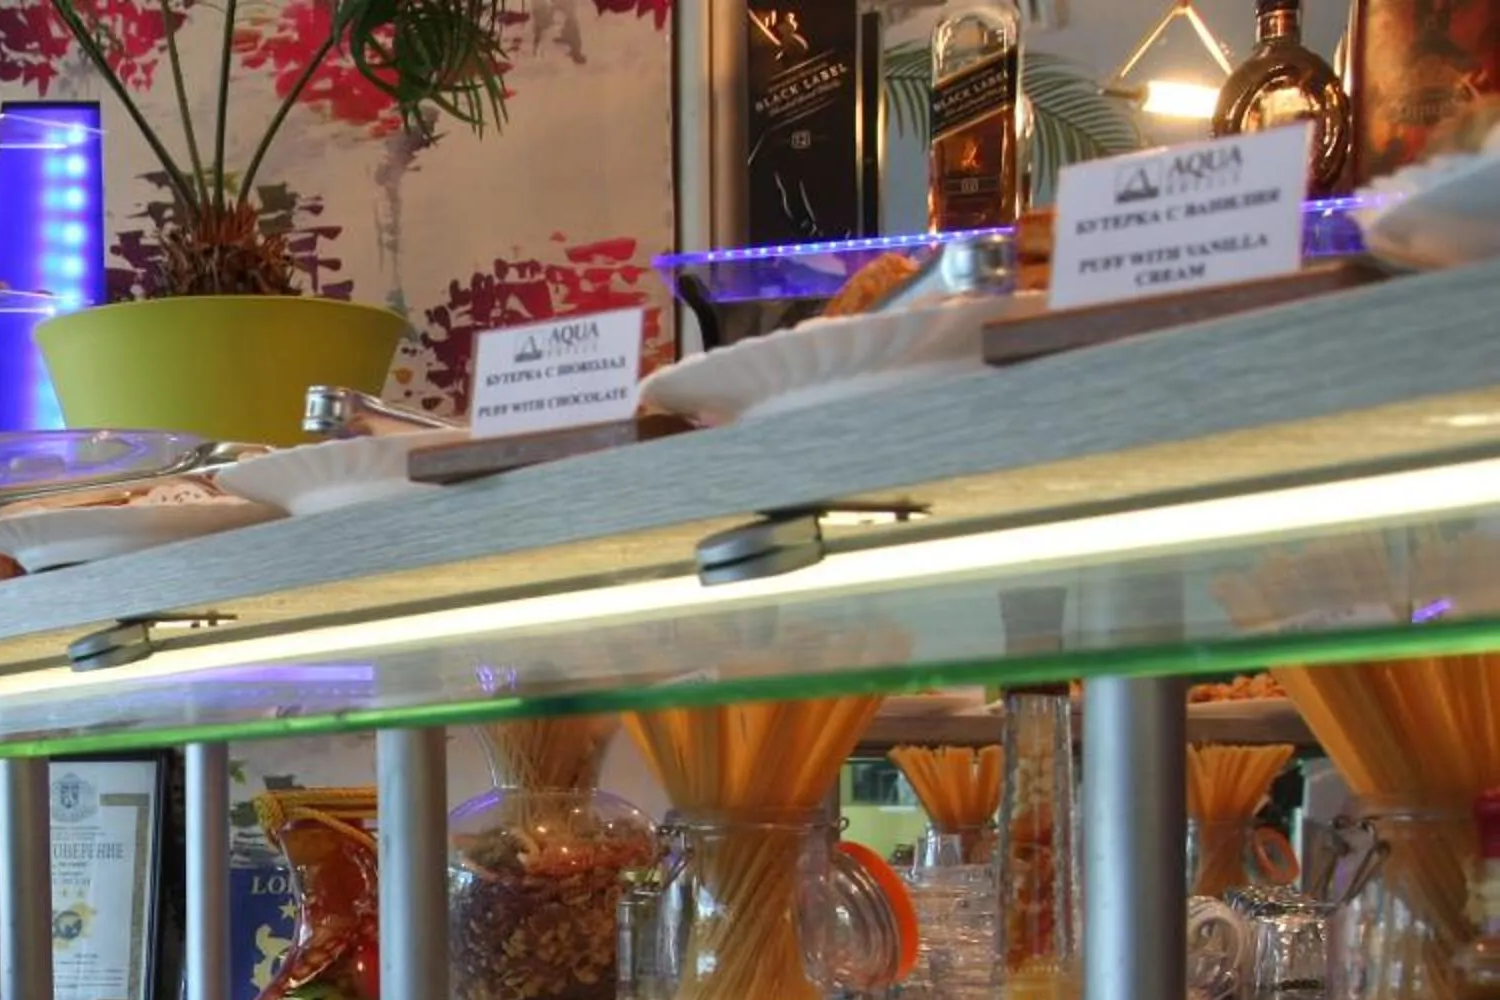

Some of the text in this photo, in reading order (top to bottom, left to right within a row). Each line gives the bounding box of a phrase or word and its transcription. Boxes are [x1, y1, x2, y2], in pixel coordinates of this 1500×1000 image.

[755, 84, 799, 112] BLACK
[802, 63, 848, 90] LABEL
[1169, 147, 1241, 177] AQUA
[1079, 256, 1124, 274] PUFF
[1130, 246, 1180, 265] WITH
[1135, 264, 1204, 286] CREAM
[551, 323, 598, 344] AQUA
[478, 388, 627, 417] PUFF WITH CHOCOLATE
